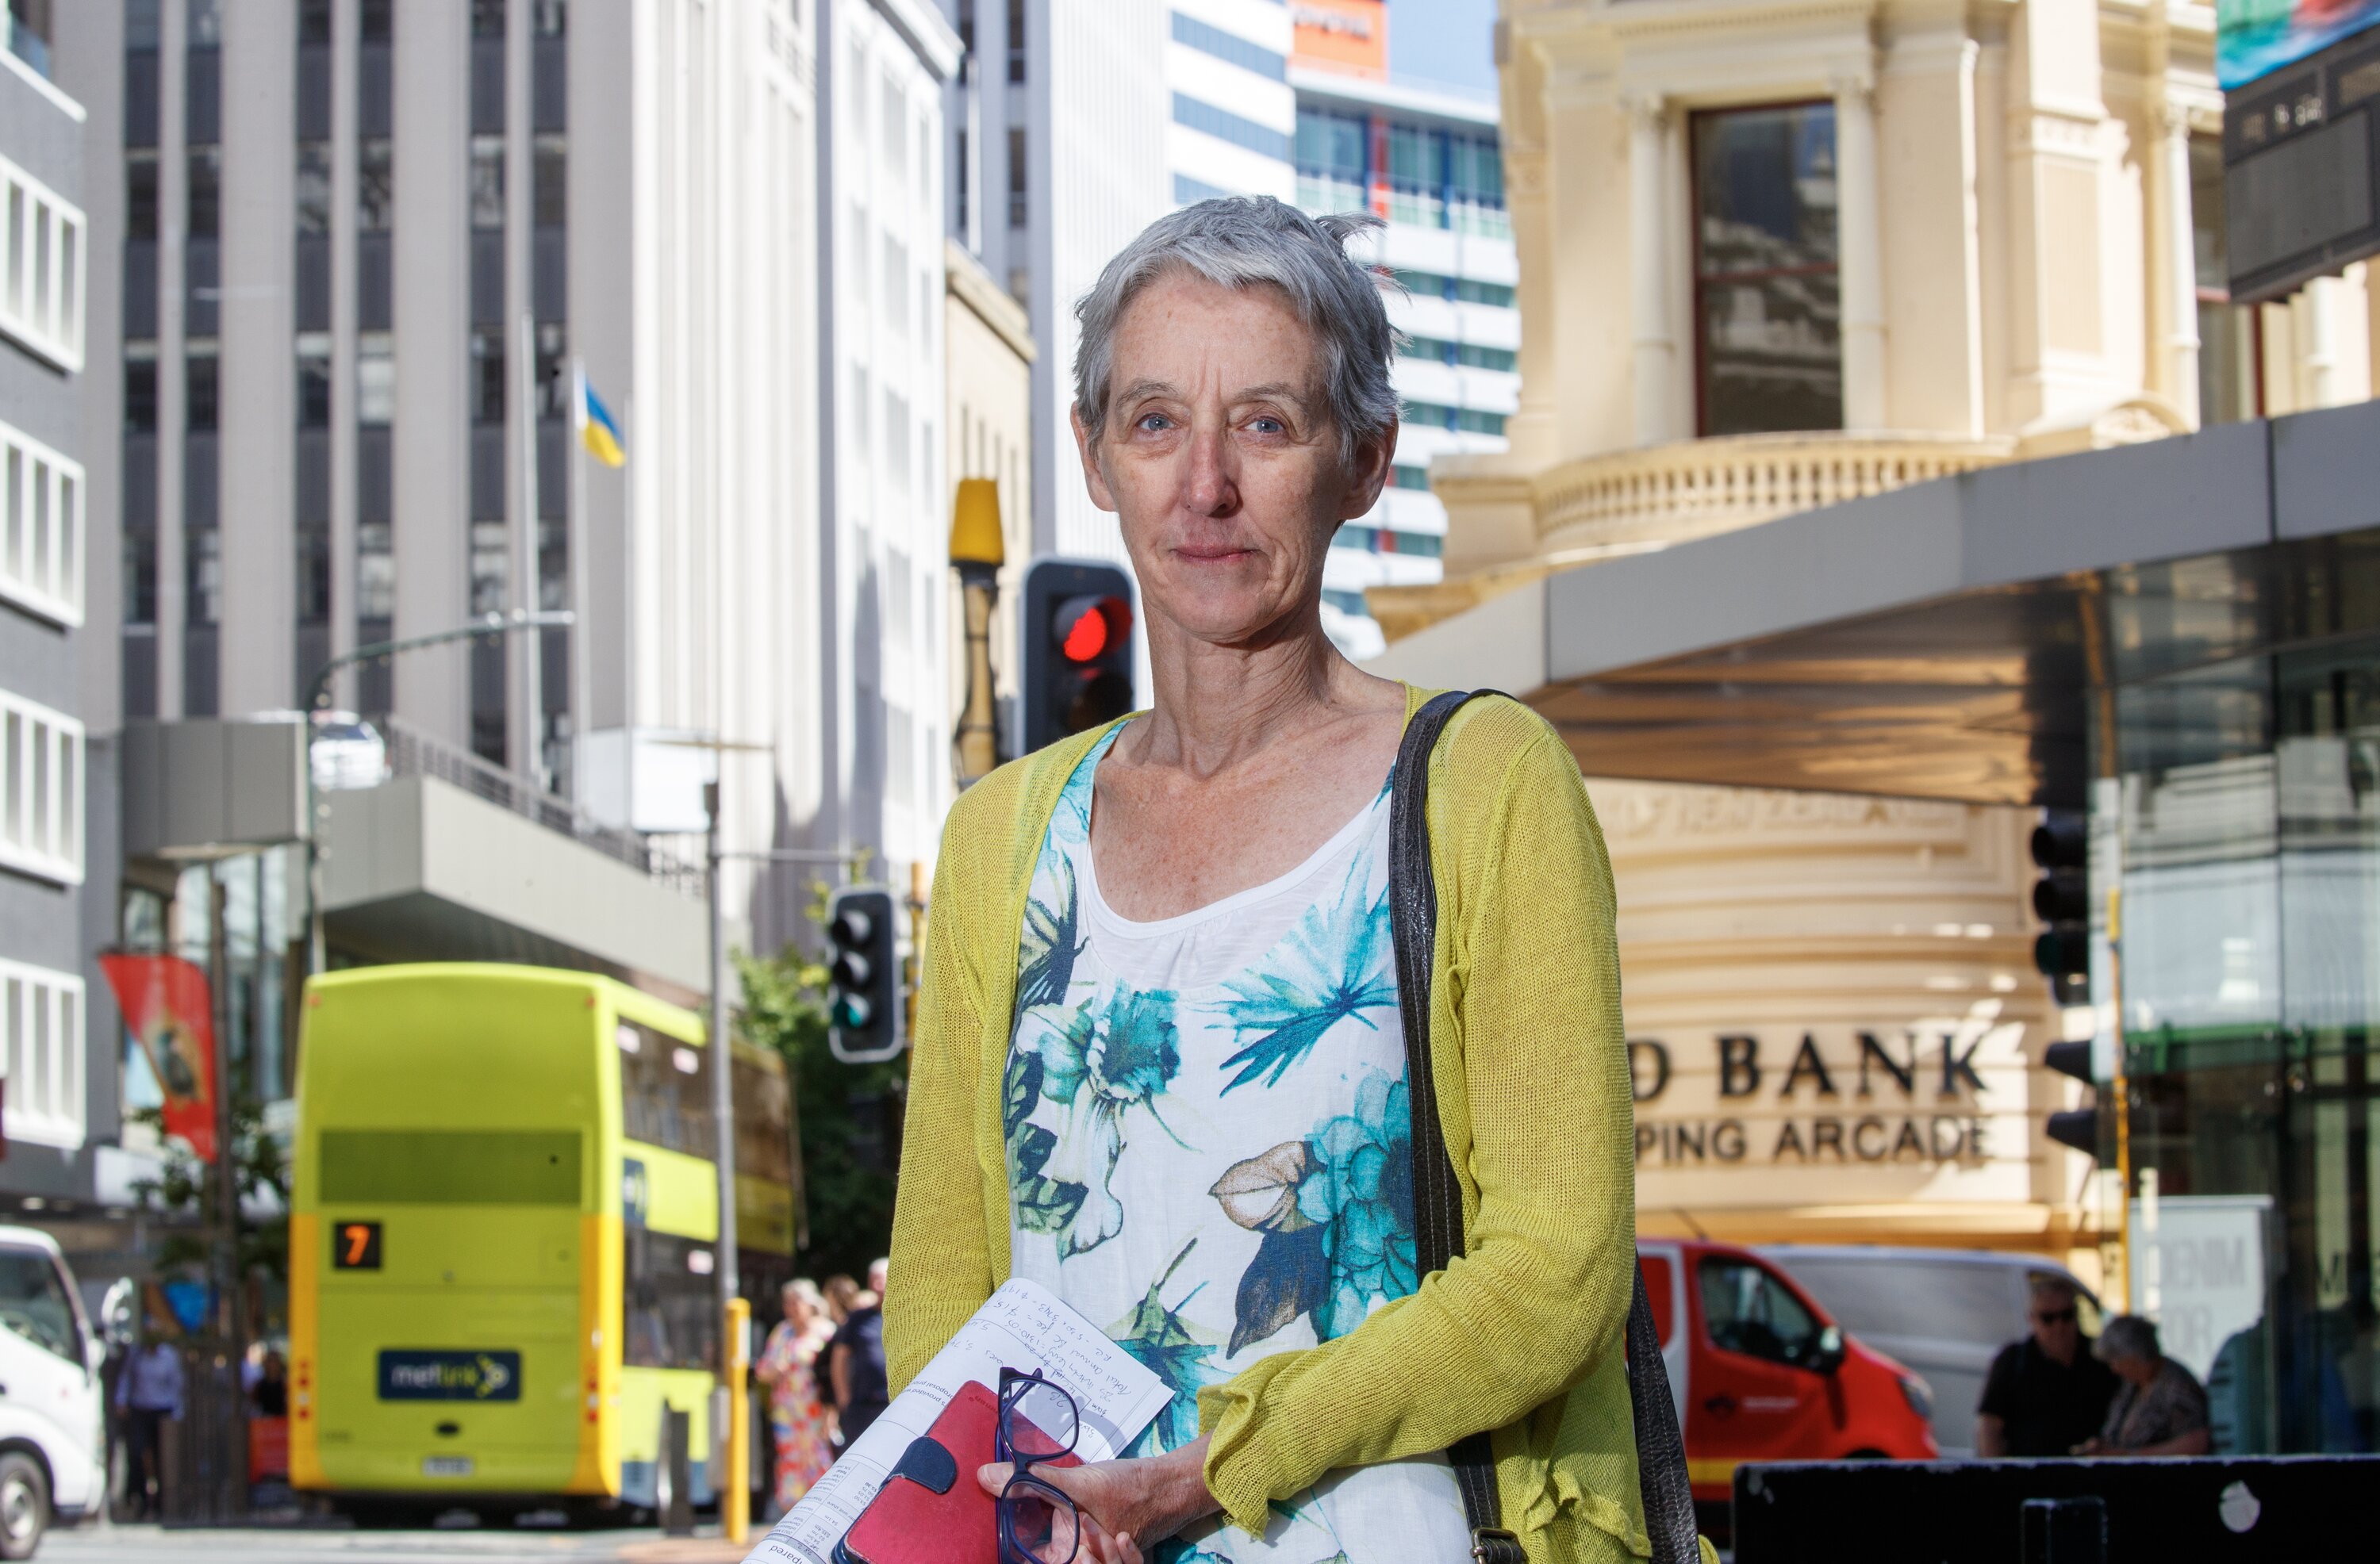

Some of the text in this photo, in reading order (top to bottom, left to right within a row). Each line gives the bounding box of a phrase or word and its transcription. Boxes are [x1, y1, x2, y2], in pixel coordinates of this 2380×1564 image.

[1630, 1029, 1993, 1100] D BANK
[1635, 1114, 1996, 1162] PING ARCADE
[344, 1224, 370, 1265] 7
[912, 1388, 942, 1402] provided
[768, 1544, 803, 1564] pared
